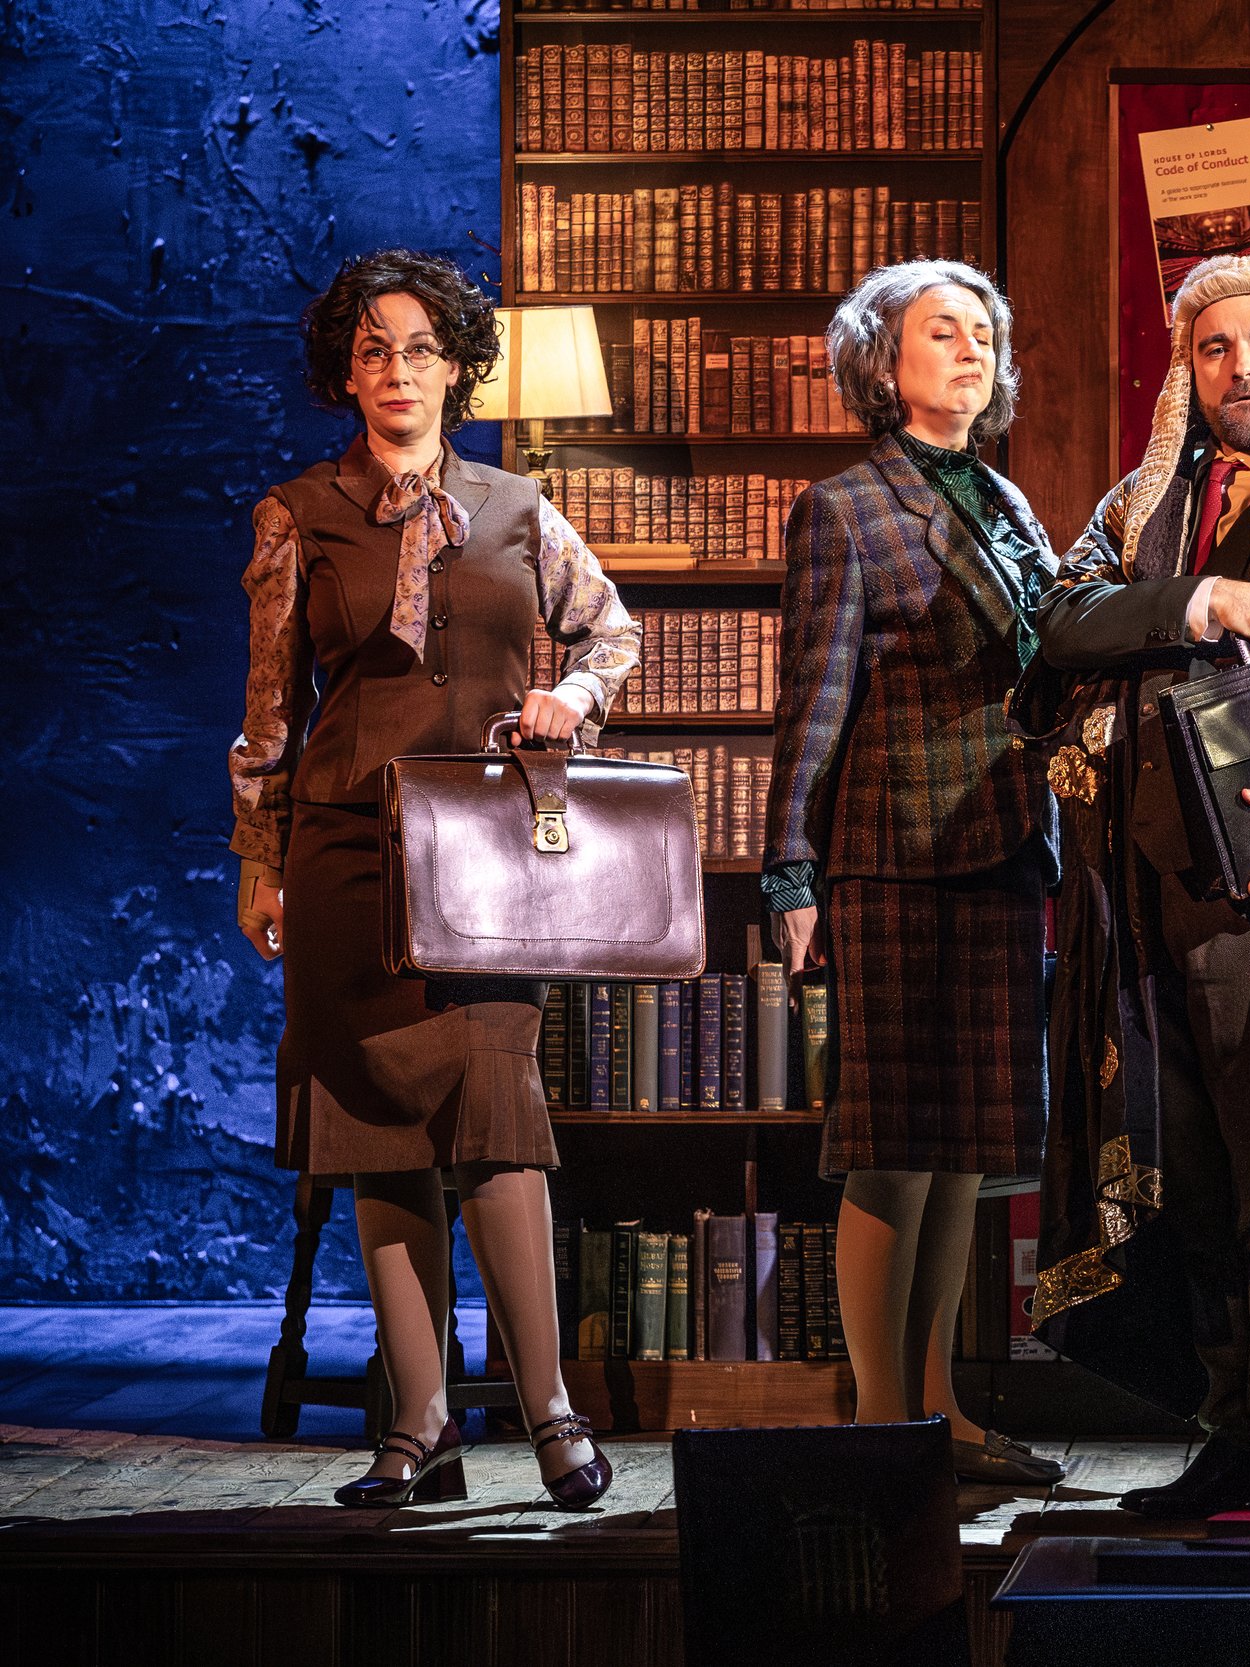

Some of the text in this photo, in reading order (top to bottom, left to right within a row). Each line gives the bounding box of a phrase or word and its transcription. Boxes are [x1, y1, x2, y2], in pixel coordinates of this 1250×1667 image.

[1154, 155, 1182, 164] HOUSE
[1199, 148, 1227, 158] LORDS
[1155, 155, 1249, 177] Code of Conduct
